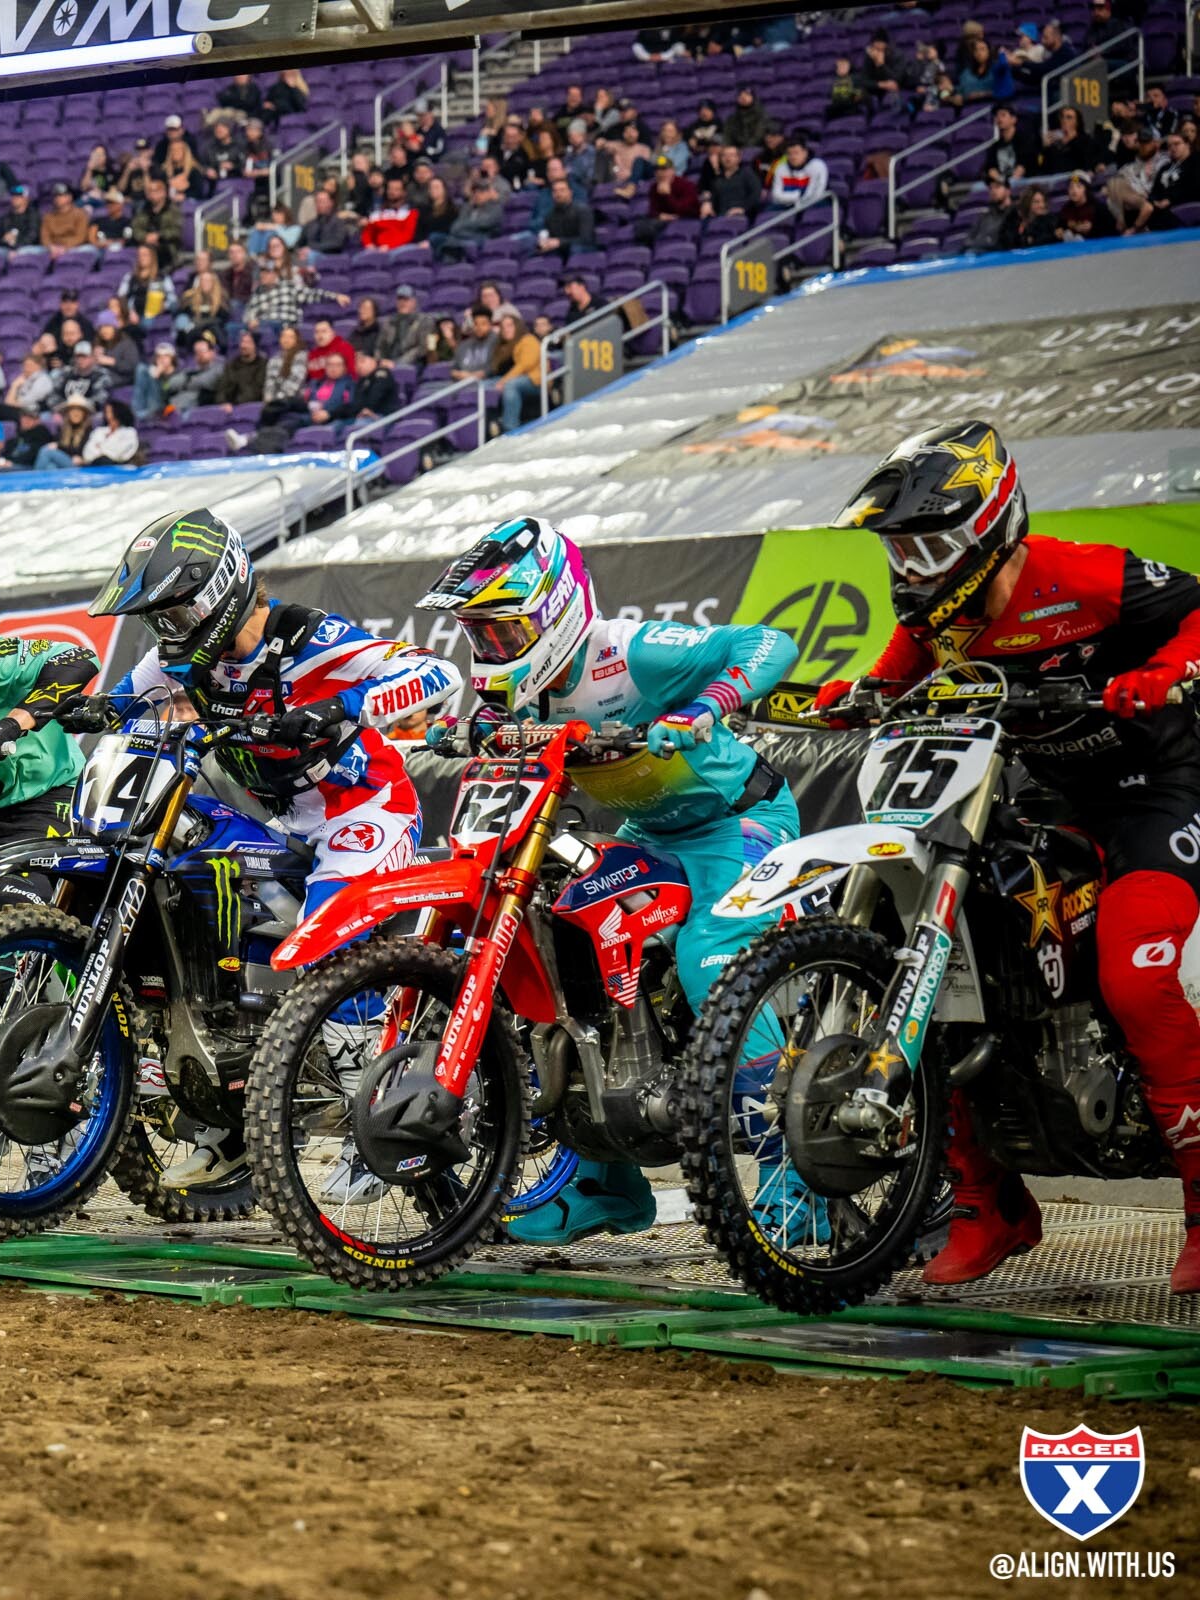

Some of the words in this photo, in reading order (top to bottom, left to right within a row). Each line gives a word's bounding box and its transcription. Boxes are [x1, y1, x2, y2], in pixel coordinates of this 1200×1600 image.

[1073, 77, 1100, 107] 118
[735, 258, 768, 293] 118
[578, 338, 614, 373] 118
[928, 551, 1001, 628] ROCKSTAR
[1034, 601, 1078, 619] MOTOREX
[211, 703, 244, 717] thor
[865, 738, 975, 812] 15
[452, 783, 533, 836] 62
[600, 931, 632, 949] HONDA
[70, 938, 111, 1032] DUNLOP
[94, 965, 114, 1005] BRAKING
[909, 943, 949, 1022] MOTOREX
[440, 973, 477, 1061] DUNLOP
[342, 1243, 412, 1271] DUNLOP
